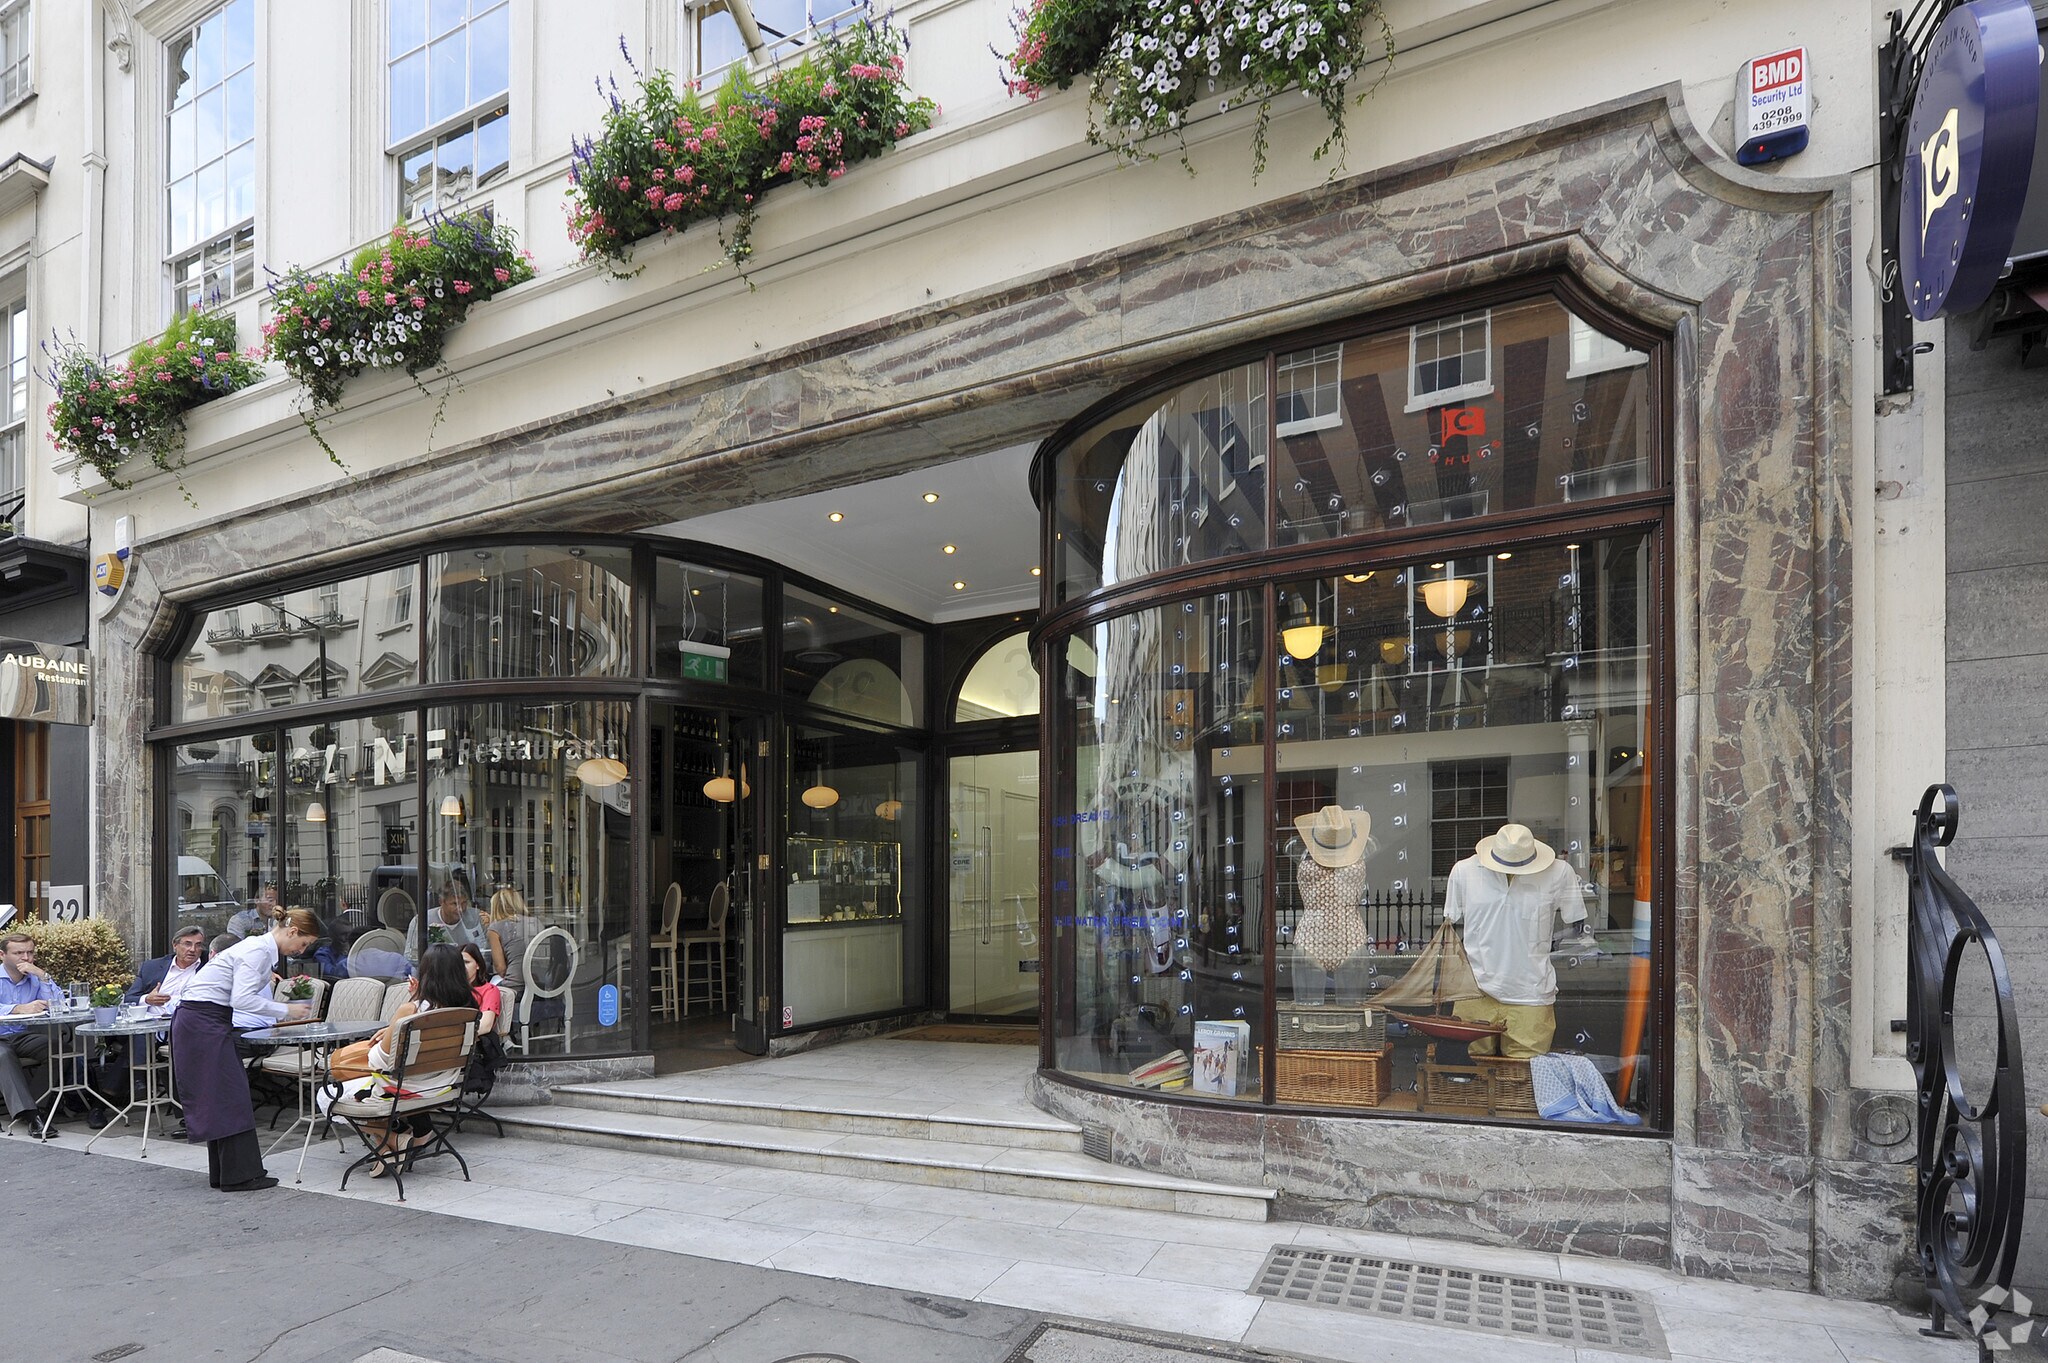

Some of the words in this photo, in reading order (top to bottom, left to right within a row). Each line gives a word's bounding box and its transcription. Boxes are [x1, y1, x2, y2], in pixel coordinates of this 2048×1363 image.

[1754, 56, 1802, 90] BMD
[1752, 89, 1787, 108] Security
[1788, 82, 1802, 98] Ltd
[1752, 111, 1803, 132] 439-7999
[1761, 105, 1793, 120] 0208
[1931, 128, 1951, 197] C
[1454, 410, 1474, 431] C
[3, 653, 90, 675] AUBAINE
[38, 671, 90, 687] Restaurant
[458, 732, 619, 766] Restaurant
[52, 898, 80, 924] 32
